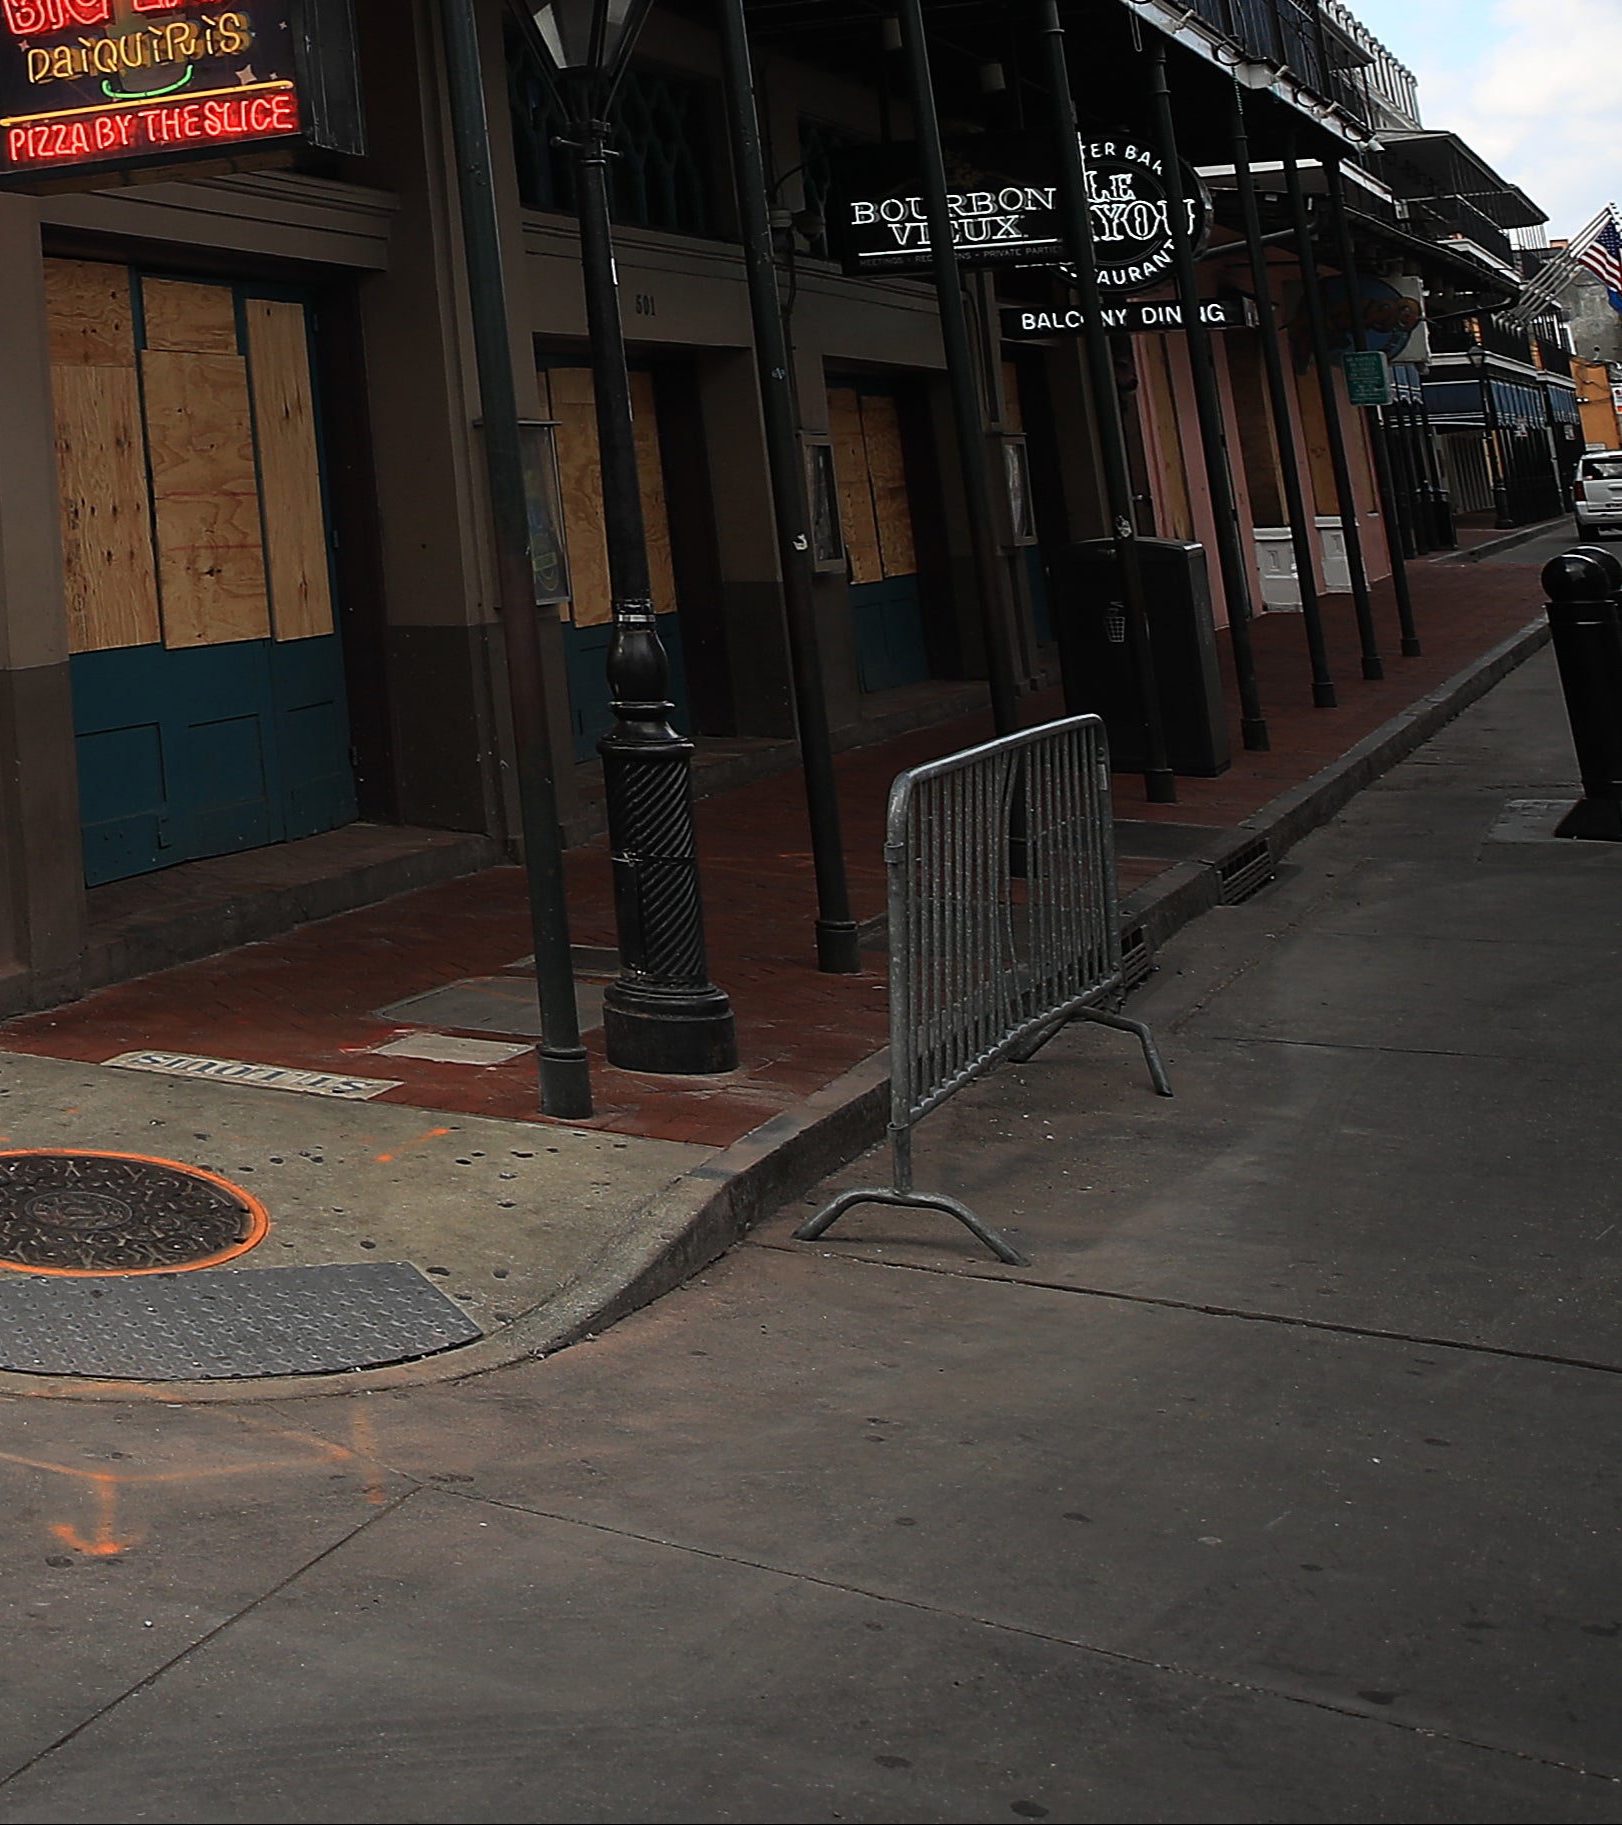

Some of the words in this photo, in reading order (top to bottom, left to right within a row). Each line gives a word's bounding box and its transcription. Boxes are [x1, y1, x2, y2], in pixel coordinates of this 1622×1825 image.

[8, 121, 90, 161] PIZZA
[95, 114, 133, 150] BY
[138, 104, 203, 143] THE
[204, 95, 293, 135] SLICE
[1084, 170, 1137, 203] LE
[1091, 198, 1196, 241] YOU
[983, 248, 1022, 258] PRIVATE
[635, 293, 656, 317] 501
[1021, 308, 1127, 330] BALCNY
[1141, 303, 1225, 325] DING
[129, 1052, 285, 1082] LOUIS
